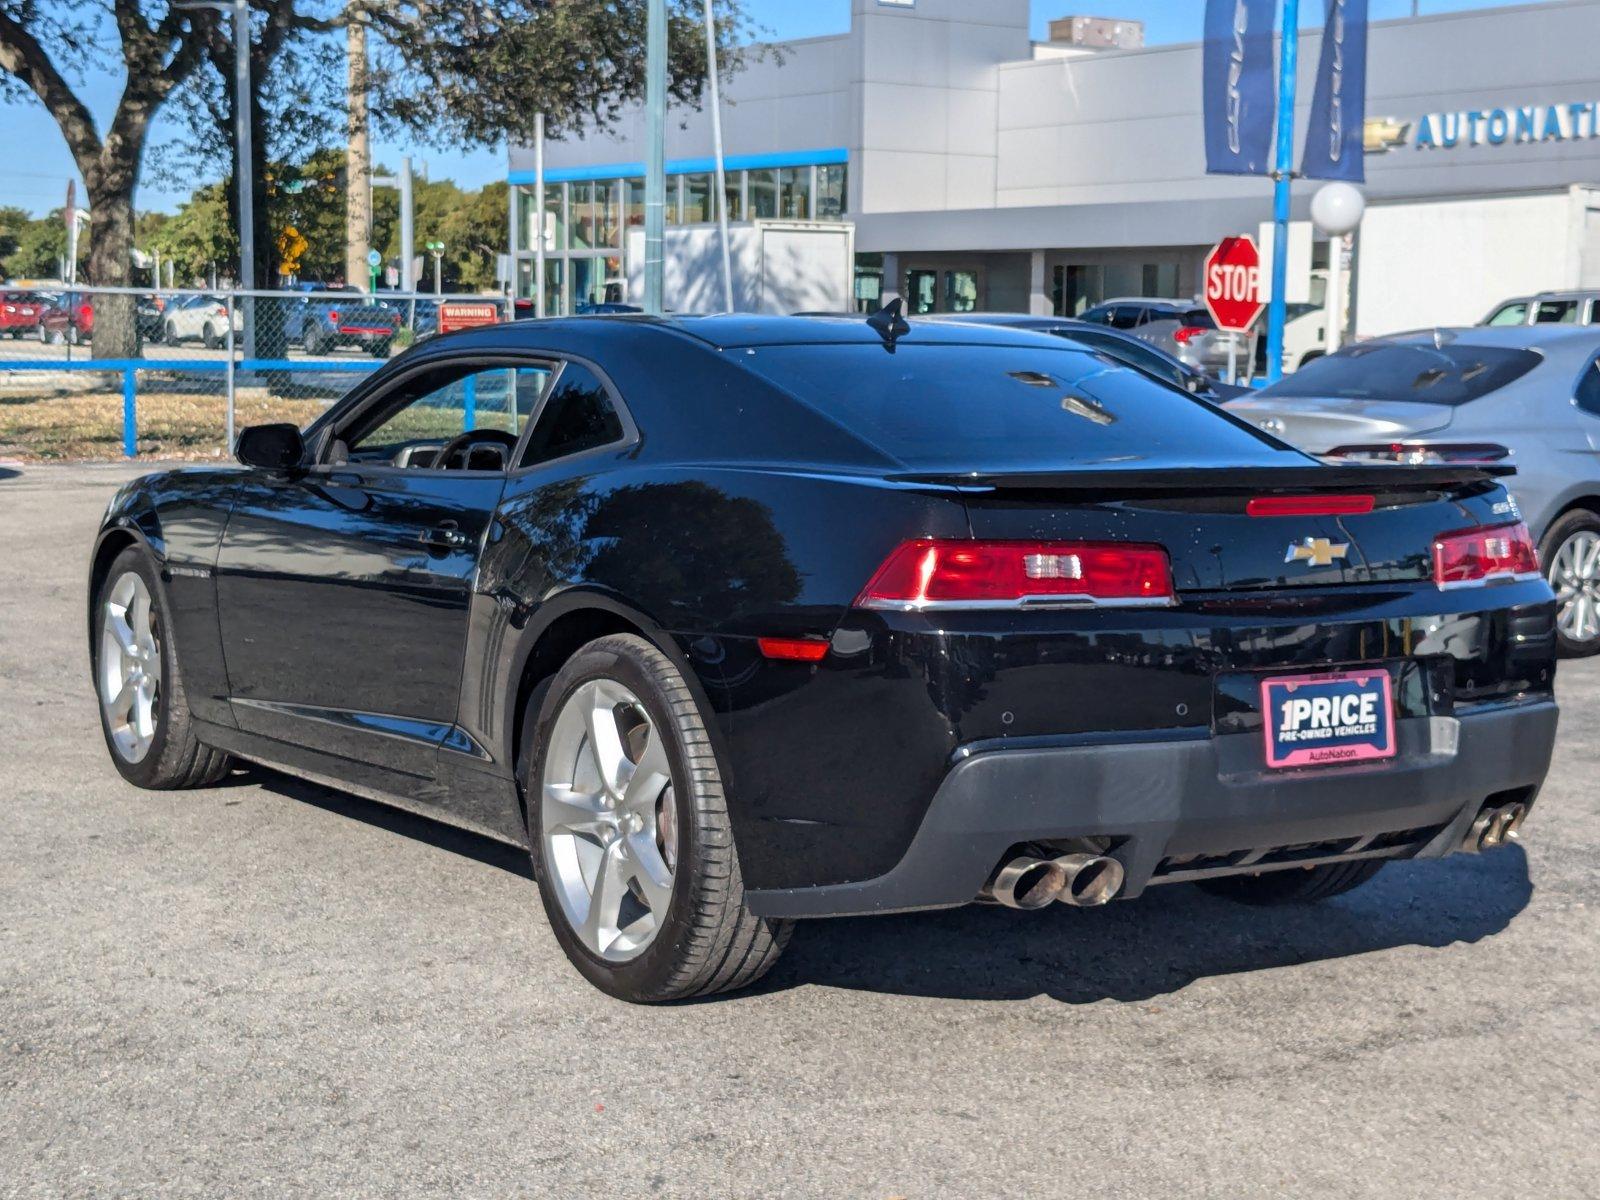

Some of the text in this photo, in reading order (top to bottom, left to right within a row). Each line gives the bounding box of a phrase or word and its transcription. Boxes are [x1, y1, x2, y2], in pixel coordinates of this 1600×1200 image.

[446, 308, 492, 317] WARNING
[1279, 723, 1377, 742] PRE-OWNED VEHICLES
[1309, 748, 1357, 761] AutoNation
